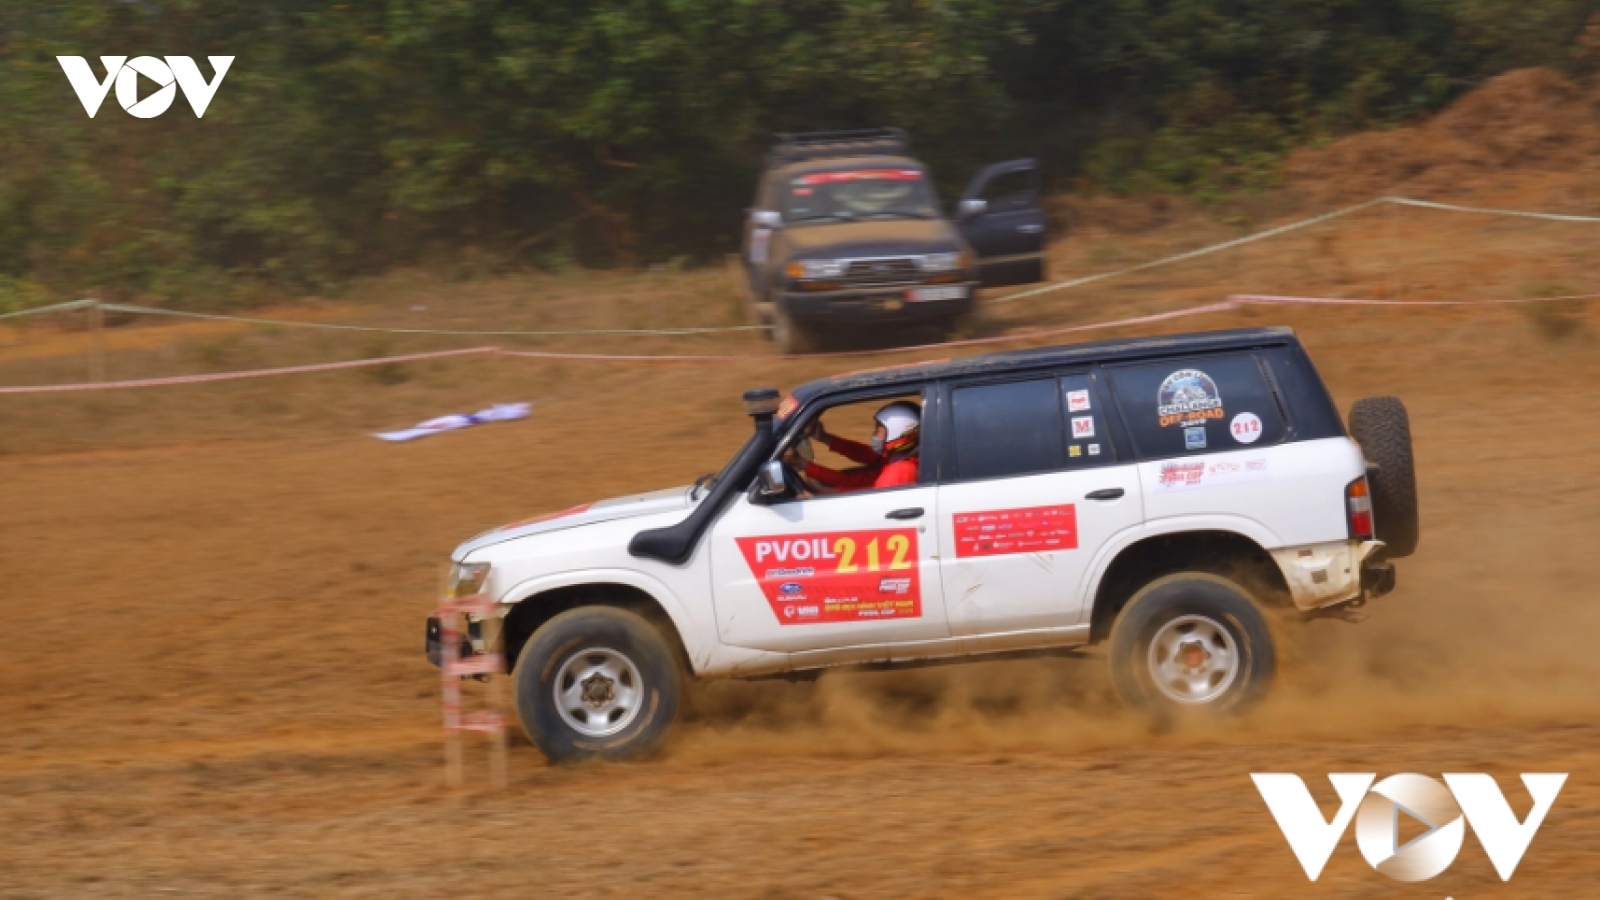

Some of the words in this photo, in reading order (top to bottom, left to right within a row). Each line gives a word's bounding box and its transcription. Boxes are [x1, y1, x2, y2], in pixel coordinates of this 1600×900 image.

[1159, 407, 1224, 428] OFF-ROAD
[1234, 419, 1259, 435] 212
[756, 538, 836, 562] PVOIL
[833, 535, 912, 574] 212
